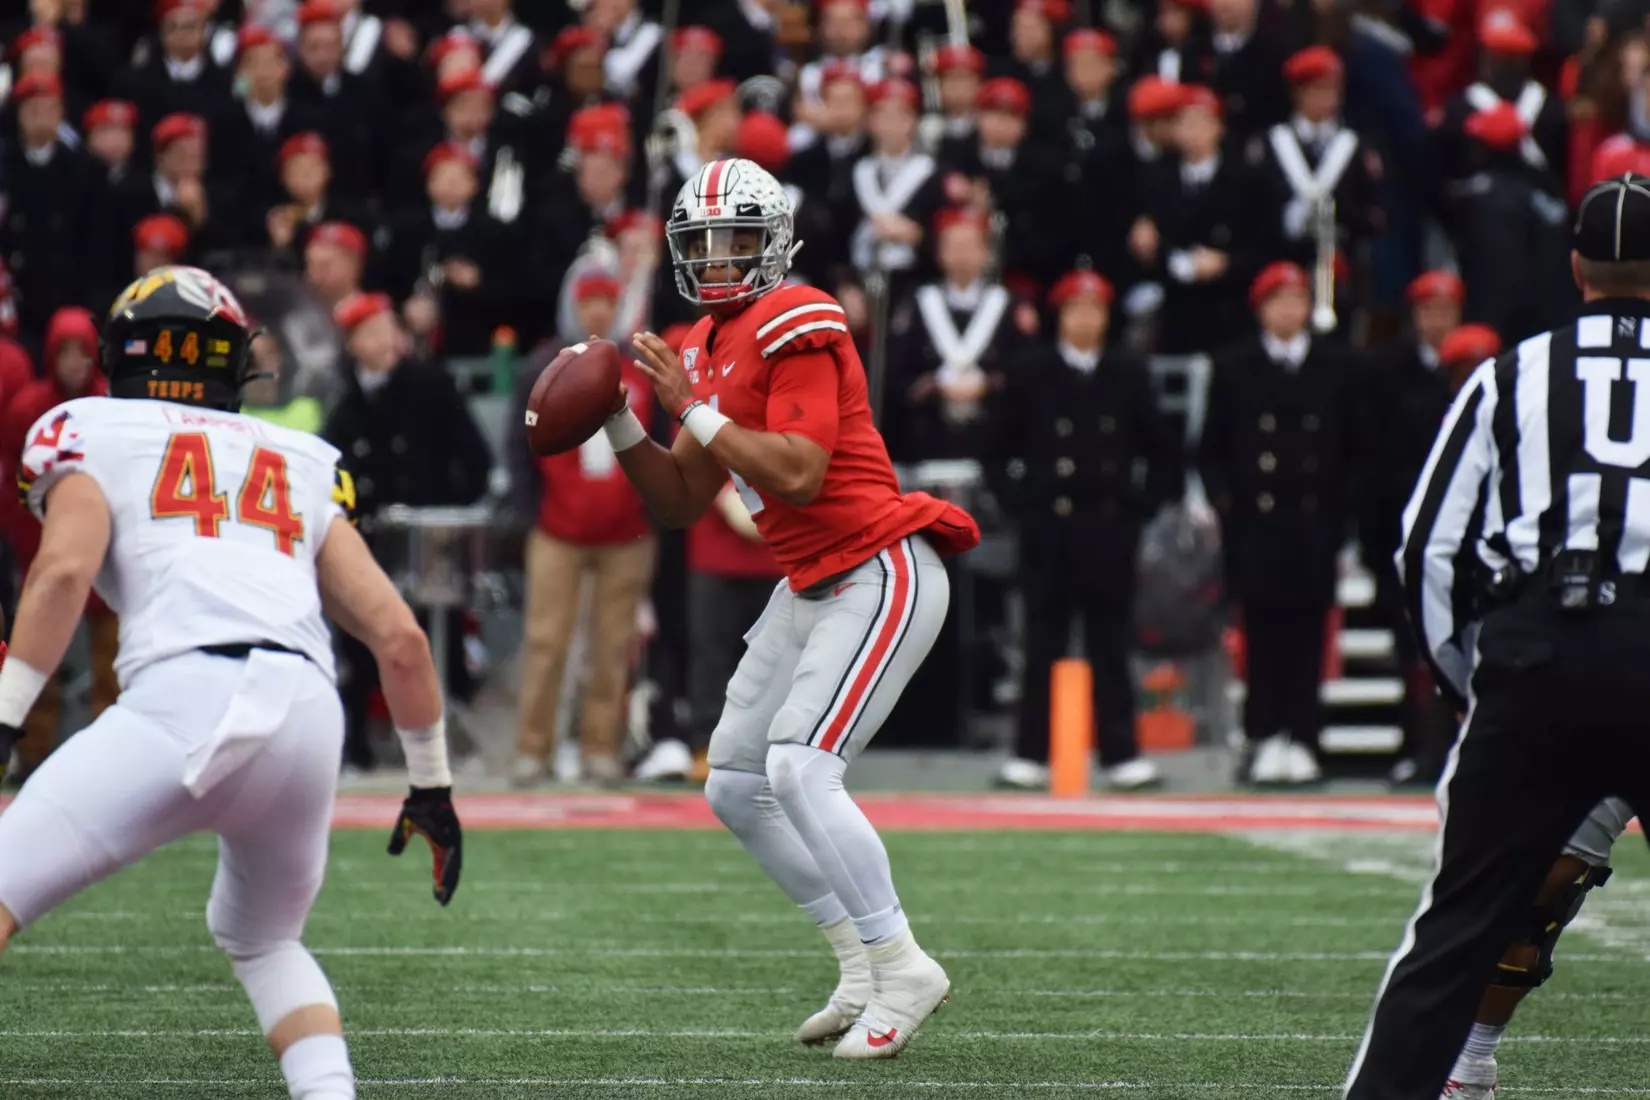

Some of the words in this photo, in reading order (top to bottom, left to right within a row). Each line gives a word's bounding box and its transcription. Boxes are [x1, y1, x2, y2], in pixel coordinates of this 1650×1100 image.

[154, 330, 199, 365] 44
[148, 380, 204, 399] TERPS
[1576, 356, 1650, 469] U
[152, 432, 304, 559] 44
